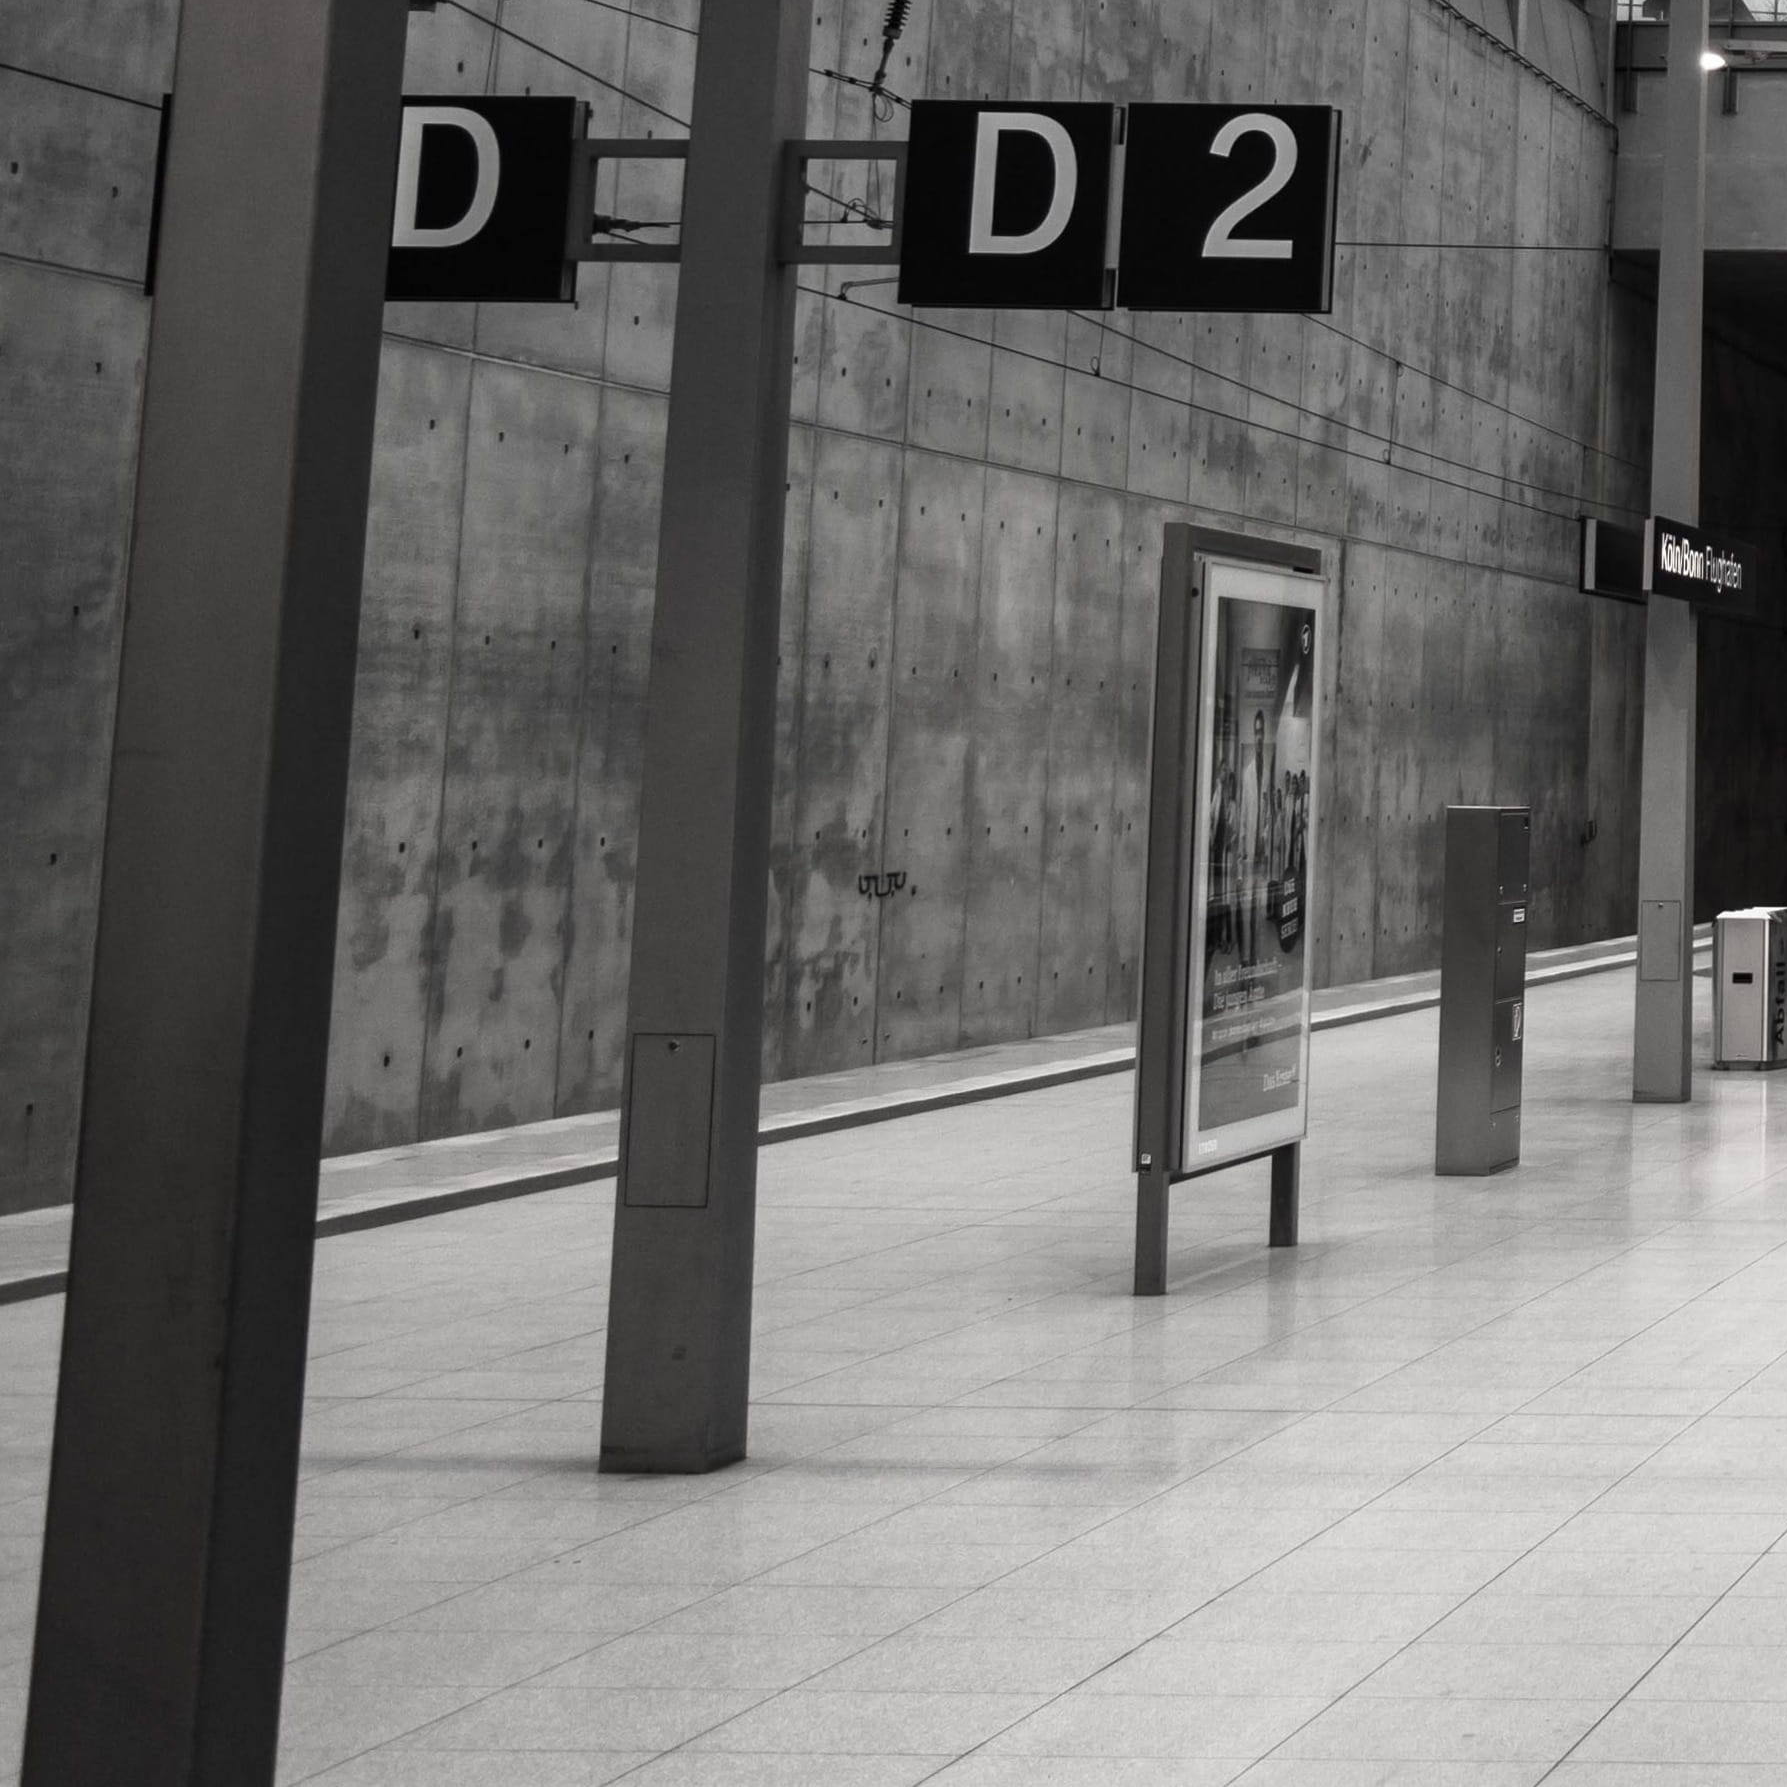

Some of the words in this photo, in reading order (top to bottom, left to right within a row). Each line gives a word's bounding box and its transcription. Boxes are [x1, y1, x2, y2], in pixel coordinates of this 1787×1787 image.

[391, 105, 501, 249] D
[968, 111, 1079, 257] D
[1201, 112, 1299, 260] 2
[1660, 531, 1704, 581] Köln/Bonn
[1704, 544, 1743, 594] Flughafen
